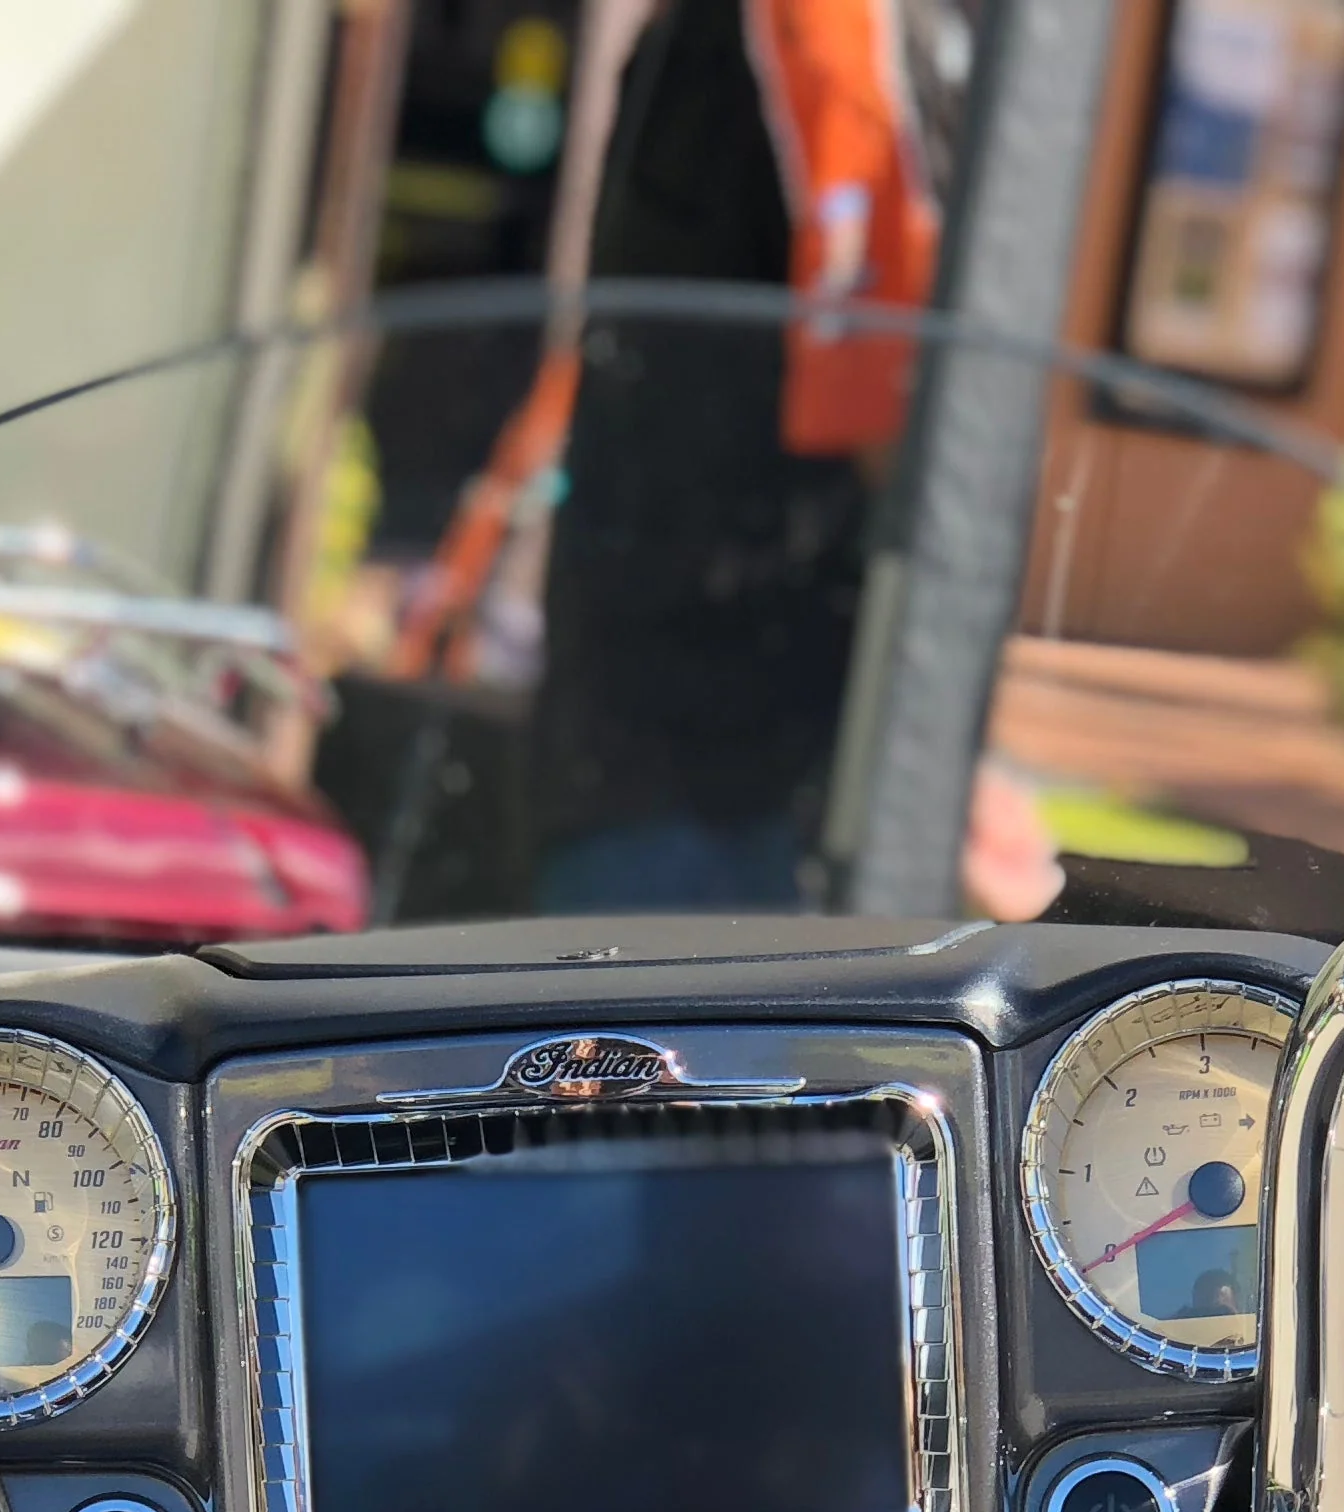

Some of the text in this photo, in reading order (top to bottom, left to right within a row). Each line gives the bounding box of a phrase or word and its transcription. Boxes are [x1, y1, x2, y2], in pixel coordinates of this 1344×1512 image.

[517, 1041, 662, 1087] Indian
[1199, 1055, 1211, 1074] 3
[1125, 1088, 1137, 1107] 2
[1178, 1089, 1201, 1101] RPM
[12, 1107, 30, 1121] 70
[38, 1120, 64, 1139] 80
[67, 1144, 86, 1158] 90
[12, 1169, 30, 1187] N
[72, 1169, 105, 1188] 100
[1084, 1163, 1091, 1183] 1
[100, 1200, 121, 1215] 110
[91, 1230, 124, 1249] 120
[106, 1256, 129, 1270] 140
[101, 1276, 124, 1290] 160
[94, 1296, 116, 1310] 180
[77, 1315, 104, 1329] 200
